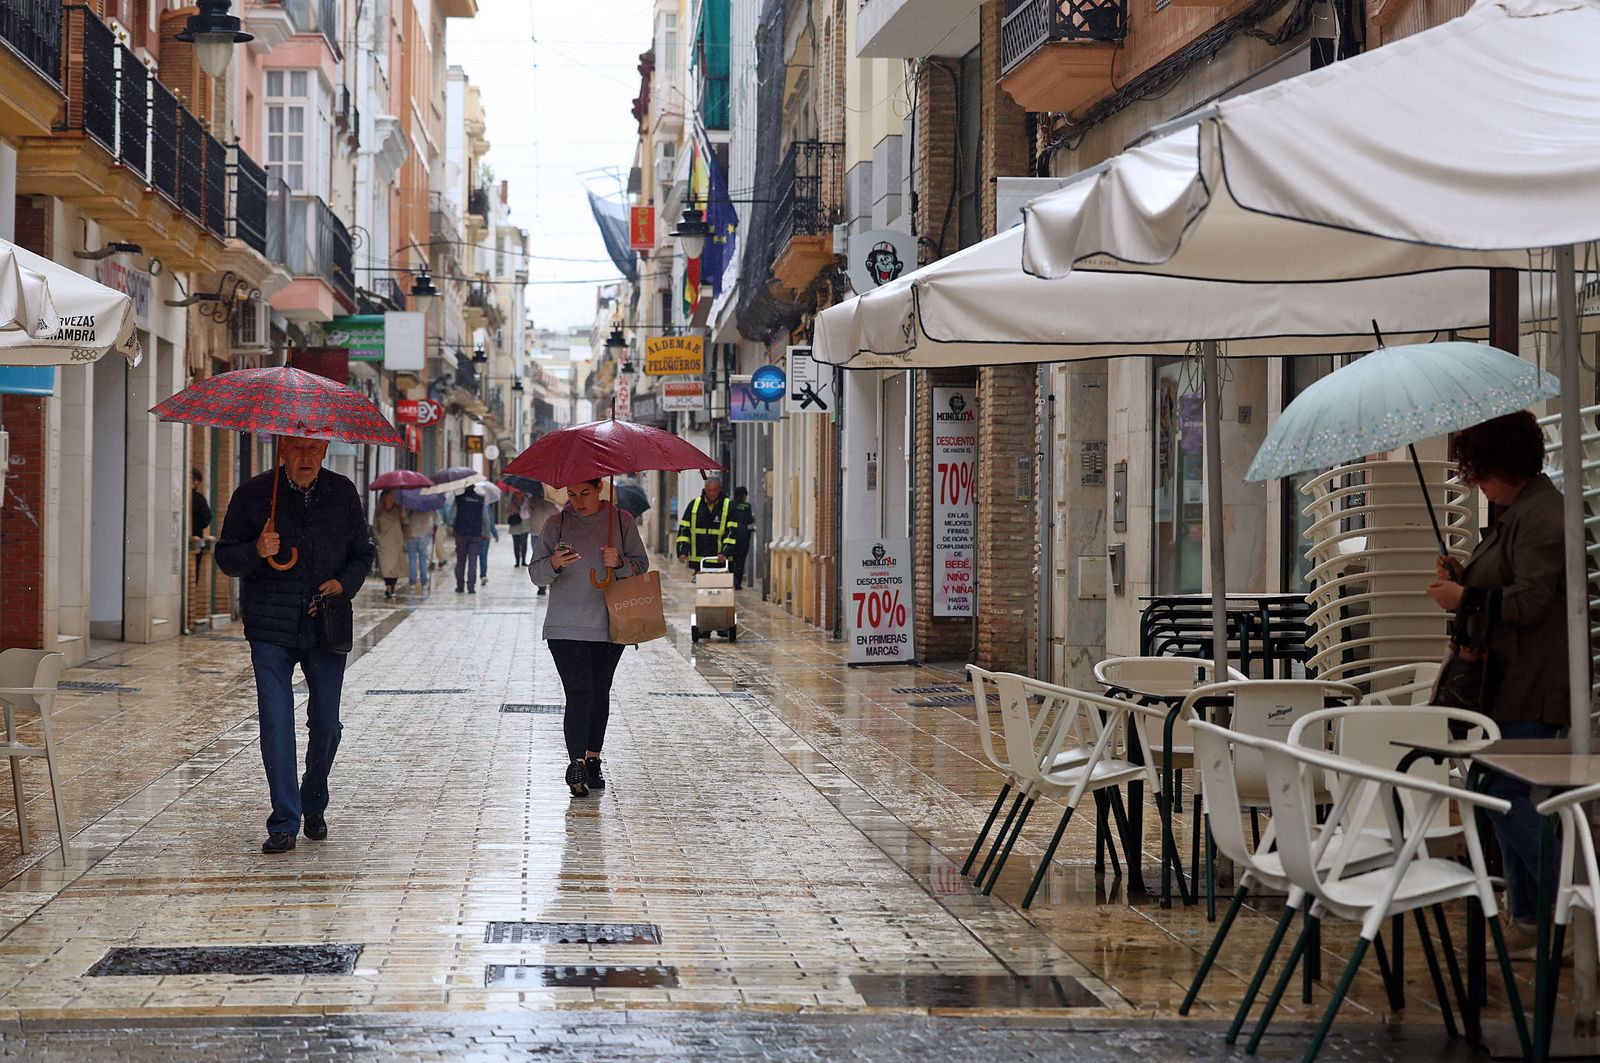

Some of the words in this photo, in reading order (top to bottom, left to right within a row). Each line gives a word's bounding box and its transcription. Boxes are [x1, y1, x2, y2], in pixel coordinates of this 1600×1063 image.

[648, 338, 700, 355] ALDEMAR
[648, 359, 701, 372] PELUQUEROS
[754, 380, 785, 389] DIGI
[936, 410, 975, 422] MONOLOK
[938, 462, 975, 506] 70%
[857, 577, 902, 585] DESCUENTOS
[947, 571, 969, 581] NIÑO
[952, 584, 974, 594] NIÑA
[614, 597, 652, 612] pepco
[852, 590, 906, 628] 70%
[857, 636, 867, 645] EN
[869, 634, 907, 644] PRIMERAS
[866, 646, 899, 656] MARCAS
